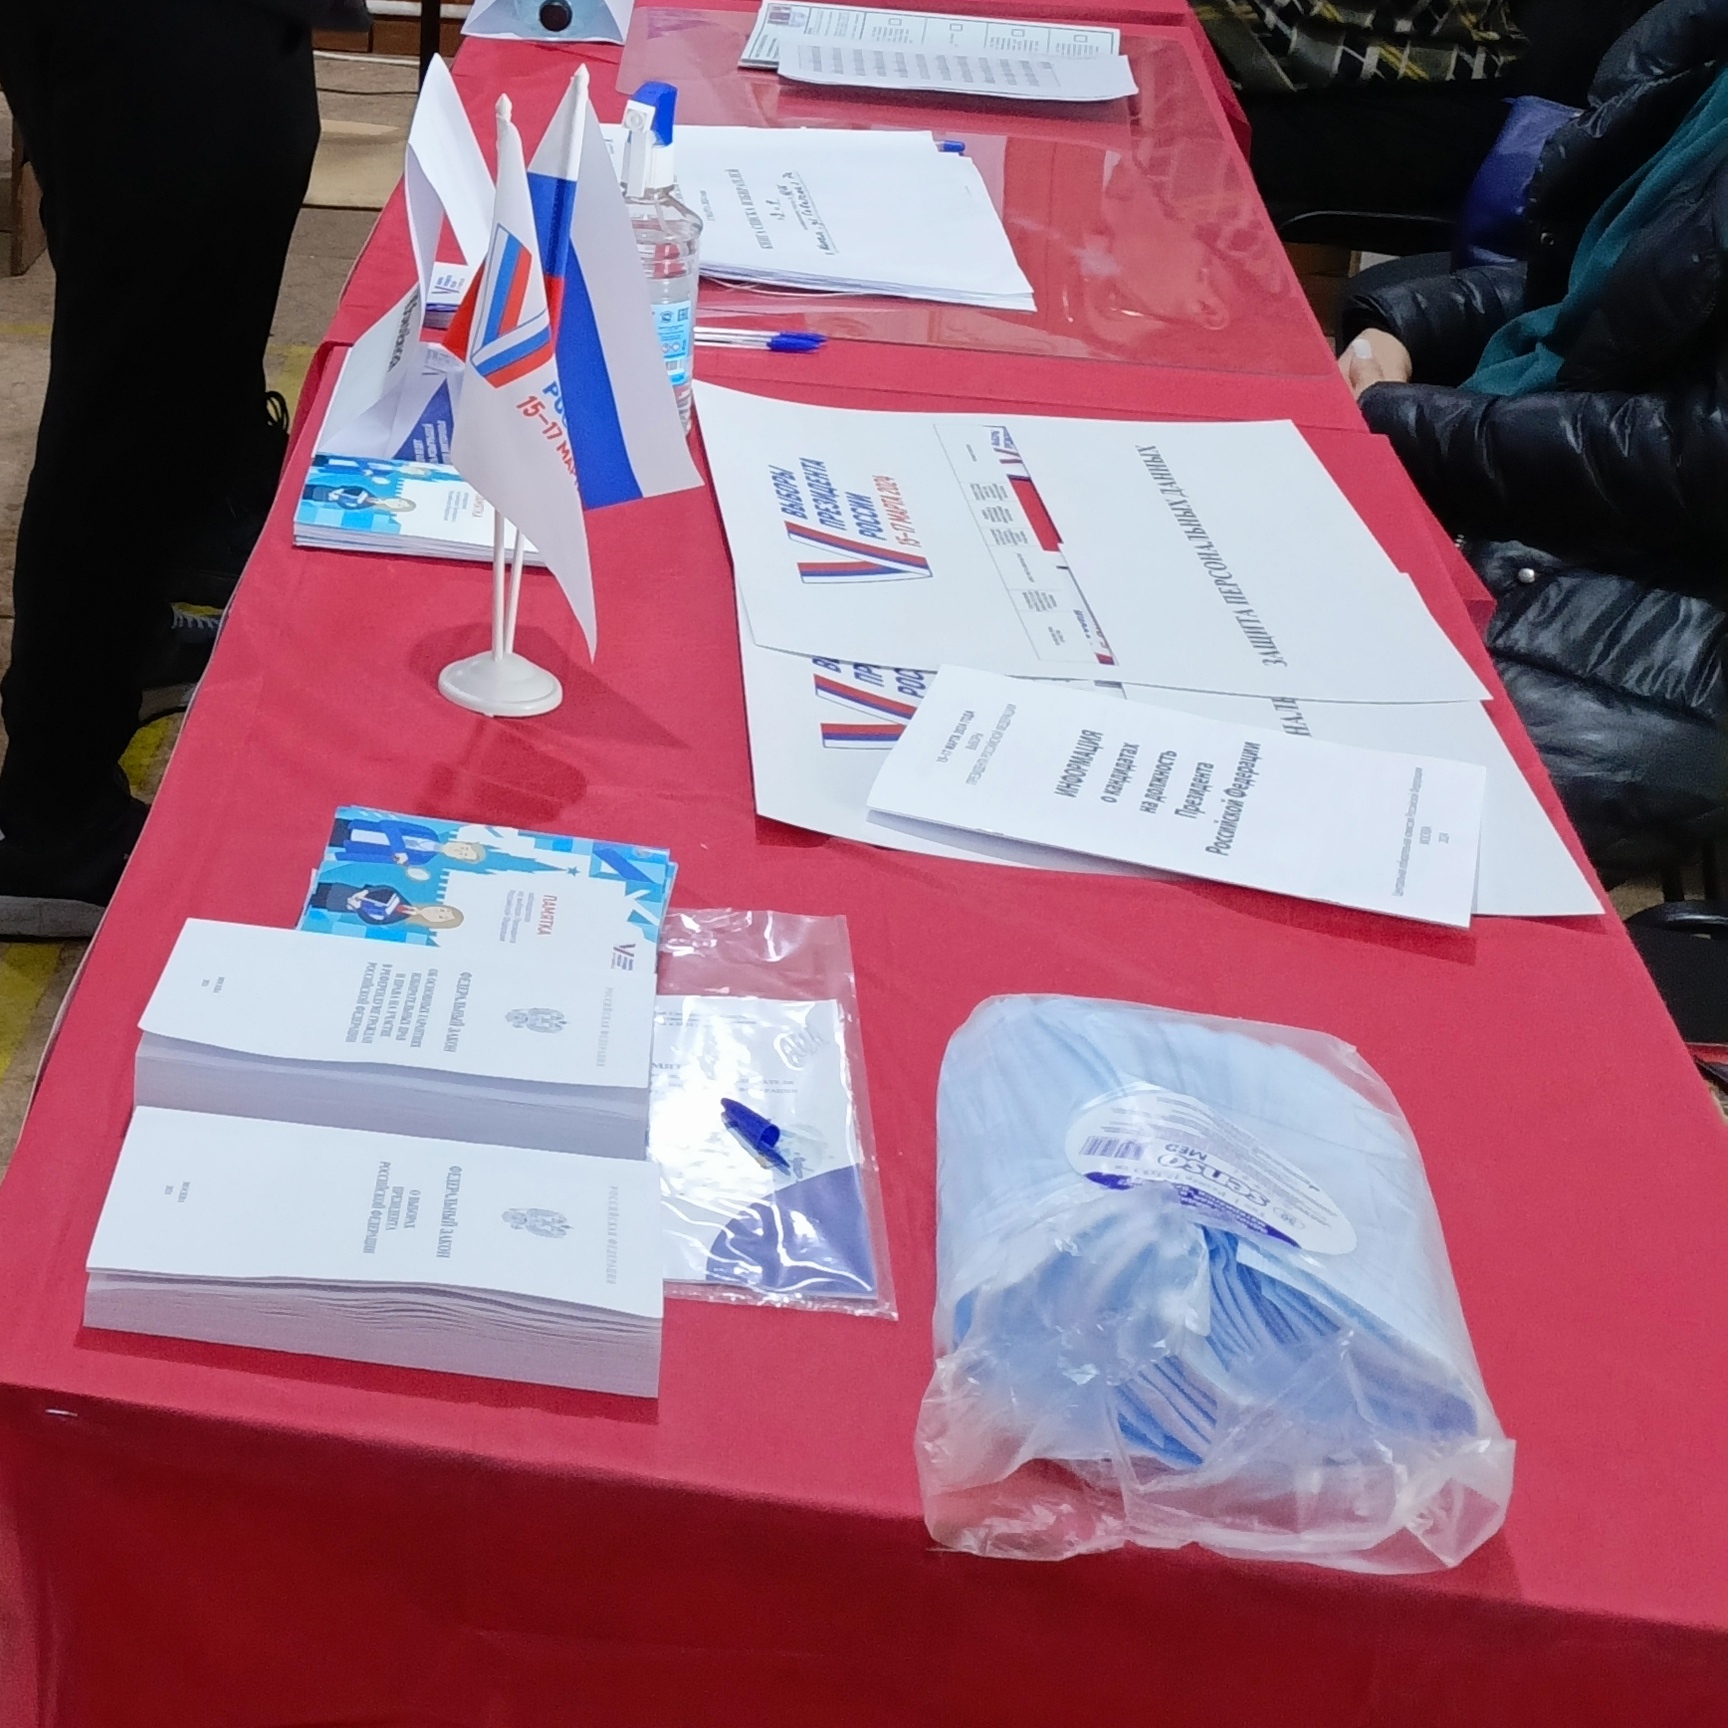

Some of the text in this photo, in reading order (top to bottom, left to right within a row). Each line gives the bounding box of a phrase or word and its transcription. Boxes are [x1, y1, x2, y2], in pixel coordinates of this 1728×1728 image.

[768, 464, 808, 520] ВЫБОРЫ
[799, 457, 847, 531] ПРЕЗИДЕНТА
[845, 491, 887, 541] РОССИИ
[1135, 444, 1288, 668] ЗАЩИТА ПЕРСОНАЛЬНЫХ ДАННЫХ
[1053, 729, 1104, 798] ИНФОРМАЦИЯ
[1104, 741, 1140, 795] кандидатах
[1139, 749, 1178, 815] на должность
[1174, 761, 1214, 819] Президента
[1205, 741, 1261, 857] Российской Федерации
[537, 895, 557, 935] ПАМЯТКА
[443, 972, 472, 1053] ФЕДЕРАЛЬНЫЙ ЗАКОН
[436, 1165, 462, 1258] ФЕДЕРАЛЬНЫЙ ЗАКОН
